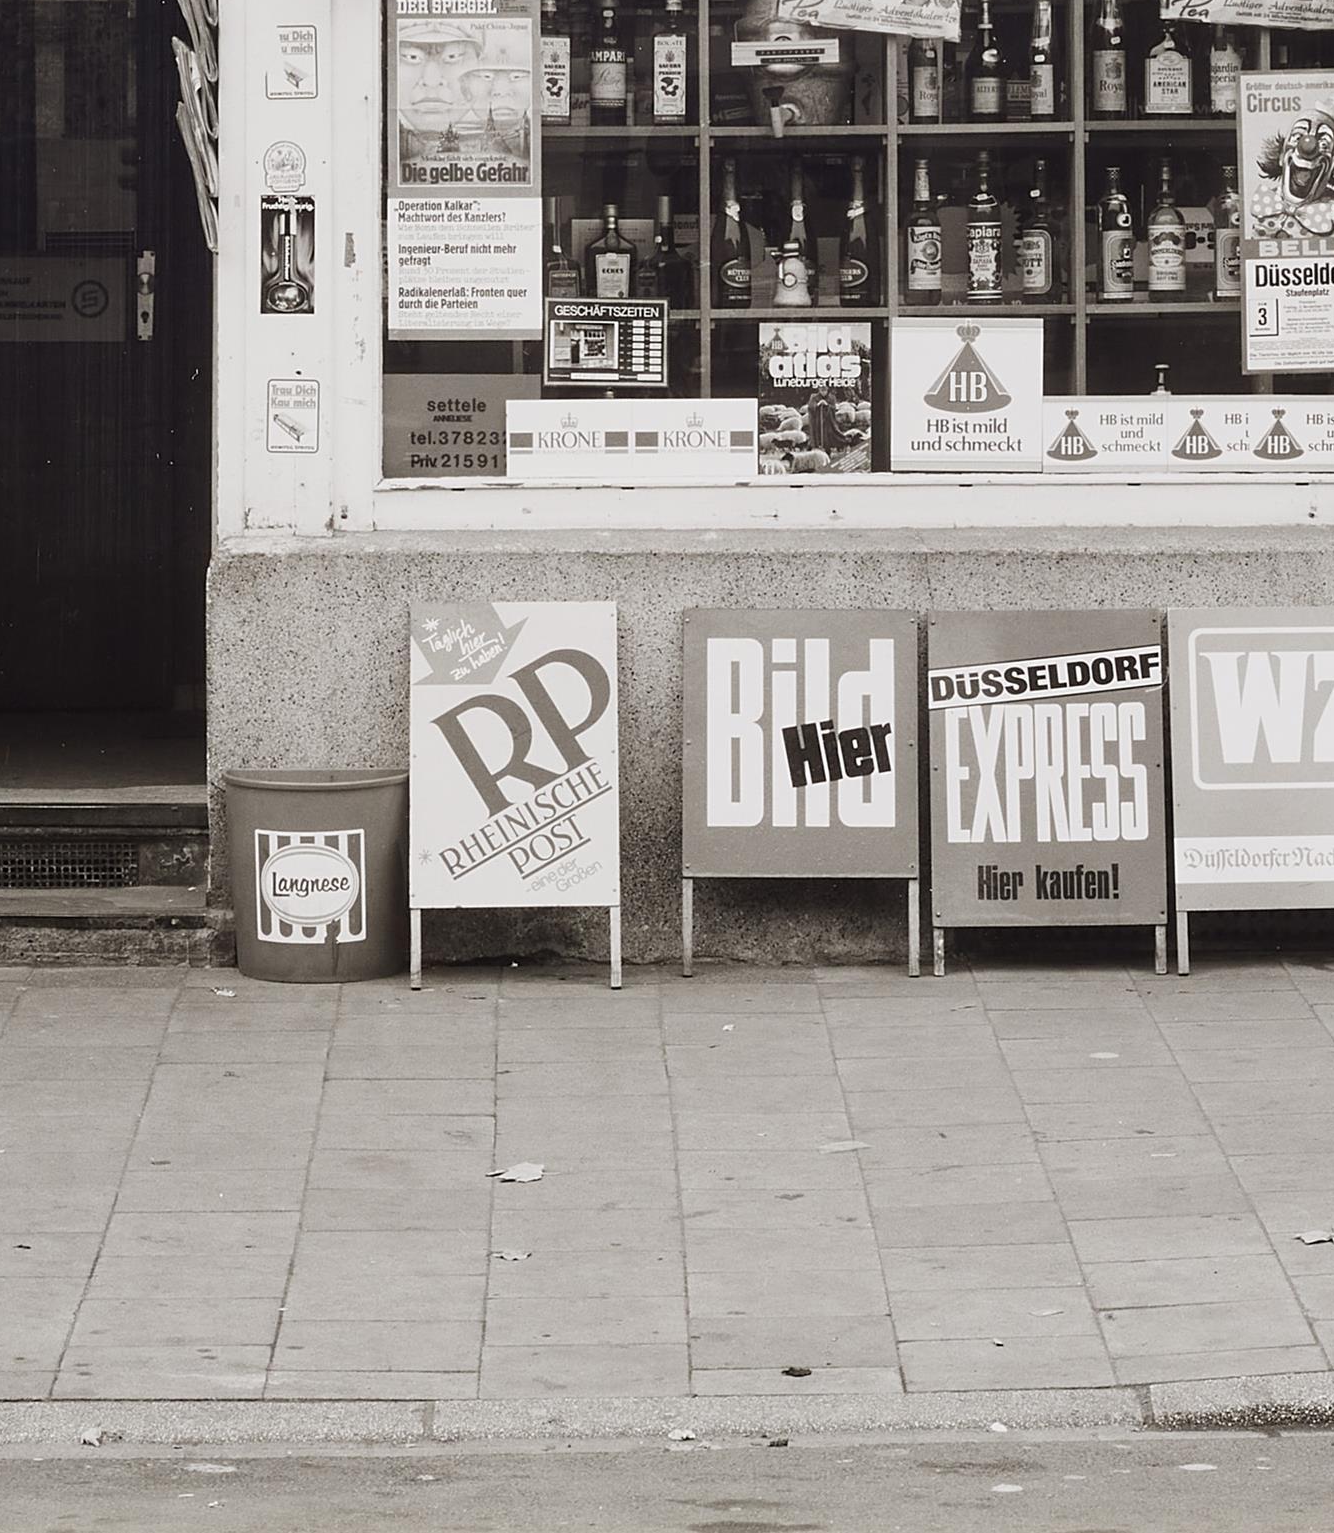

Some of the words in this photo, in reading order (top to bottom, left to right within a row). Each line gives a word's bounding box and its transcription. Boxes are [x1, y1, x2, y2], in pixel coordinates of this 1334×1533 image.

[292, 30, 313, 41] Dich
[291, 43, 313, 53] mich
[1246, 94, 1302, 113] Circus
[402, 163, 427, 183] Die
[429, 163, 474, 184] gelbe
[476, 162, 528, 183] Gefahr
[398, 212, 445, 223] Machtwort
[447, 212, 462, 222] des
[464, 212, 506, 223] Kanzlers?
[398, 244, 469, 255] Ingenieur-Beruf
[470, 244, 492, 254] nicht
[493, 244, 517, 254] mehr
[398, 256, 431, 267] gefragt
[398, 287, 469, 298] Radikalenerlaß:
[471, 287, 505, 297] Fronten
[507, 288, 527, 298] quer
[1285, 289, 1330, 298] Staufenplatz
[398, 299, 422, 309] durch
[425, 299, 439, 309] die
[441, 299, 478, 309] Parteien
[555, 303, 660, 318] GESCHÄFTSZEITEN
[1258, 307, 1268, 326] 3
[769, 352, 862, 379] atlas
[271, 384, 292, 395] Trau
[295, 384, 316, 395] Dich
[949, 371, 988, 403] HB
[271, 396, 290, 407] Kau
[293, 397, 316, 407] mich
[427, 398, 486, 412] settele
[926, 419, 949, 434] HB
[952, 419, 970, 434] ist
[972, 418, 1008, 434] mild
[1100, 414, 1117, 425] HB
[1120, 414, 1134, 425] ist
[1136, 413, 1164, 425] mild
[1224, 413, 1242, 425] HB
[1306, 413, 1324, 425] HB
[538, 431, 602, 448] KRONE
[663, 431, 727, 447] KRONE
[1120, 427, 1144, 438] und
[911, 437, 936, 451] und
[938, 437, 1022, 451] schmeckt
[1061, 435, 1084, 455] HB
[1101, 440, 1161, 453] schmeckt
[1185, 435, 1209, 455] HB
[1267, 435, 1291, 455] HB
[441, 454, 507, 468] 21591
[930, 651, 1160, 703] DÜSSELDORF
[430, 648, 611, 819] RP
[707, 638, 896, 827] Bild
[781, 718, 893, 788] Hier
[944, 701, 1150, 844] EXPRESS
[438, 762, 610, 876] RHEINISCHE
[507, 813, 585, 876] POST
[271, 871, 351, 897] Langnese
[977, 865, 1023, 901] Hier
[1035, 863, 1120, 900] kaufen!
